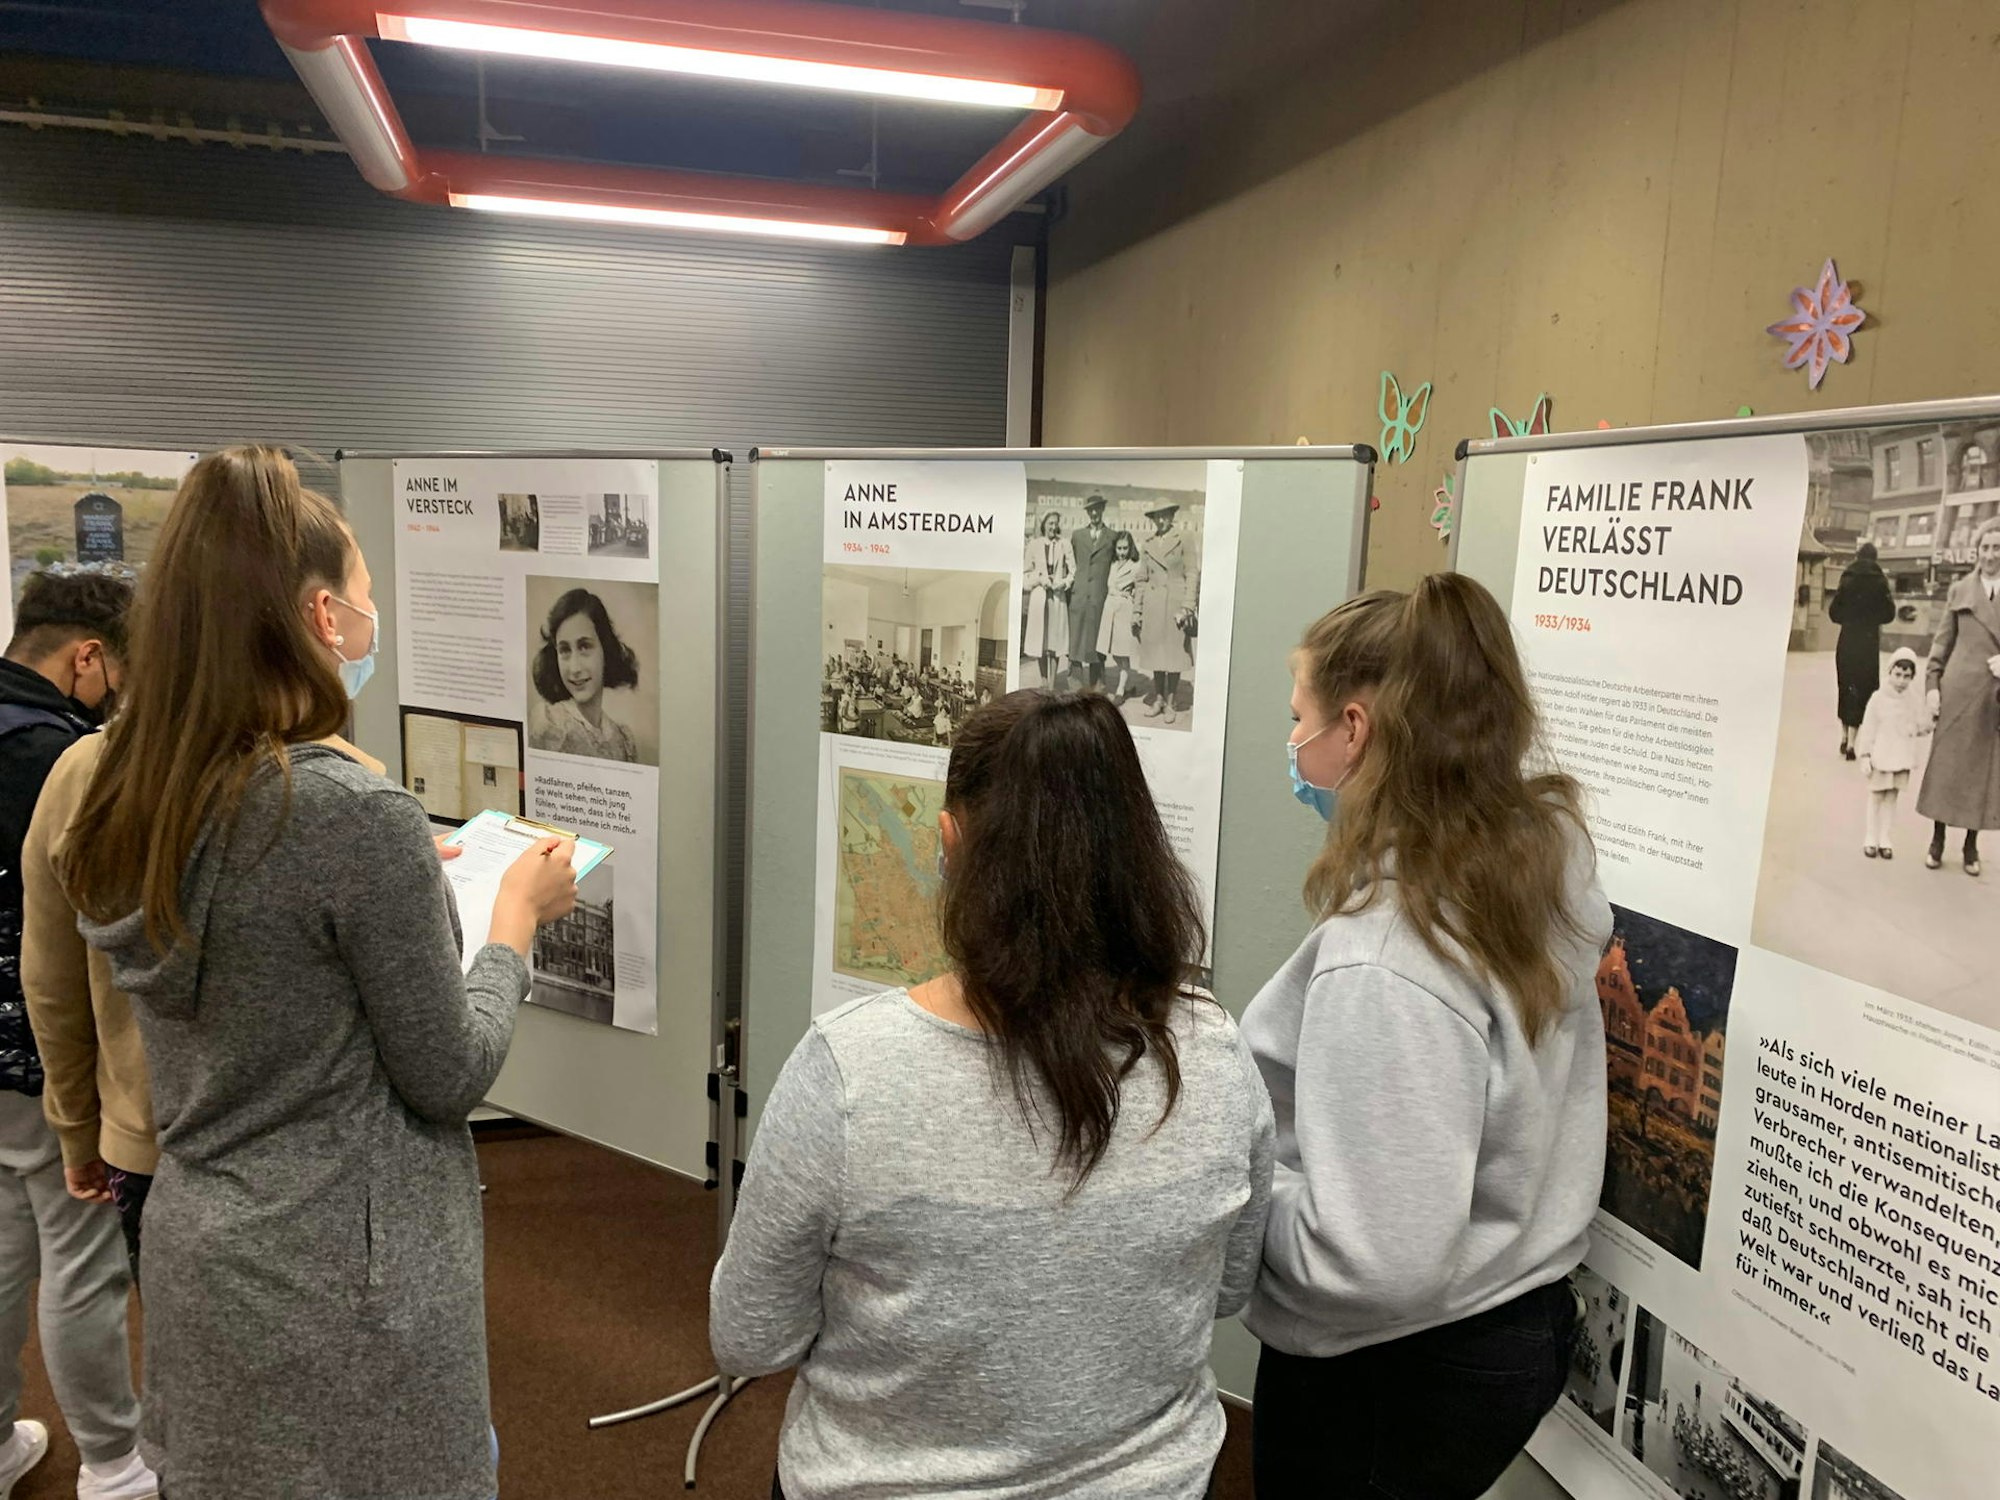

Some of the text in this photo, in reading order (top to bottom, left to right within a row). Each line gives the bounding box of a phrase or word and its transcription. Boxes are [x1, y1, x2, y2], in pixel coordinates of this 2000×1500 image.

[406, 477, 458, 493] ANNE IM
[844, 484, 897, 502] ANNE
[1547, 478, 1755, 512] FAMILIE FRANK
[407, 498, 474, 516] VERSTECK
[844, 511, 994, 534] IN AMSTERDAM
[843, 543, 862, 552] 1934
[870, 544, 890, 554] 1942
[1543, 517, 1672, 555] VERLÄSST
[1538, 566, 1743, 606] DEUTSCHLAND
[1534, 614, 1592, 632] 1933/1934
[1564, 690, 1580, 699] Adolf
[1622, 700, 1630, 708] ab
[1648, 703, 1655, 711] in
[1705, 713, 1718, 723] Die
[1601, 680, 1632, 693] Deutsche
[1633, 686, 1681, 700] Arbeiterpartei
[1696, 693, 1718, 705] ihrem
[1565, 705, 1577, 713] den
[1580, 708, 1603, 719] Wahlen
[1616, 714, 1628, 723] das
[1629, 716, 1666, 730] Parlament
[1668, 724, 1679, 732] die
[1680, 726, 1713, 738] meisten
[1579, 721, 1588, 731] Sie
[1590, 725, 1611, 734] geben
[1623, 730, 1635, 740] die
[1655, 737, 1714, 756] Arbeitslosigkeit
[1624, 763, 1637, 772] wie
[1638, 764, 1658, 776] Roma
[1661, 771, 1675, 780] und
[1651, 751, 1663, 761] Die
[1665, 755, 1684, 767] Nazis
[1686, 758, 1713, 771] hetzen
[535, 786, 626, 812] die Welt sehen, mich jung
[577, 782, 604, 795] pfeifen,
[605, 787, 632, 800] tanzen,
[1617, 777, 1655, 792] politischen
[536, 809, 546, 818] bin
[553, 813, 577, 824] danach
[579, 819, 599, 828] sehne
[600, 821, 611, 831] ich
[560, 803, 586, 815] wissen,
[588, 807, 604, 817] dass
[605, 810, 617, 820] ich
[618, 812, 630, 822] frei
[1596, 816, 1611, 827] Otto
[1613, 821, 1626, 832] und
[1628, 824, 1646, 837] Edith
[1648, 830, 1669, 845] Frank,
[1670, 838, 1683, 848] mit
[1685, 840, 1704, 853] ihrer
[1647, 846, 1659, 857] der
[1661, 850, 1704, 870] Hauptstadt
[1760, 1036, 2000, 1150] »Als sich viele meiner La
[1755, 1087, 1848, 1145] grausamer,
[1757, 1056, 2000, 1181] leute in Horden nationalist
[1754, 1107, 2000, 1248] Verbrecher verwandelten,
[1750, 1135, 2000, 1277] mußte ich die Konsequenz
[1746, 1159, 2000, 1307] ziehen, und obwohl es mic
[1744, 1184, 1992, 1333] zutiefst schmerzte, sah ich
[1736, 1253, 1831, 1325] für immer.«
[1742, 1208, 1773, 1236] daß
[1777, 1227, 1890, 1304] Deutschland
[1896, 1298, 1948, 1339] nicht
[1956, 1332, 1989, 1362] die
[1740, 1230, 2000, 1401] Welt war und verließ das La
